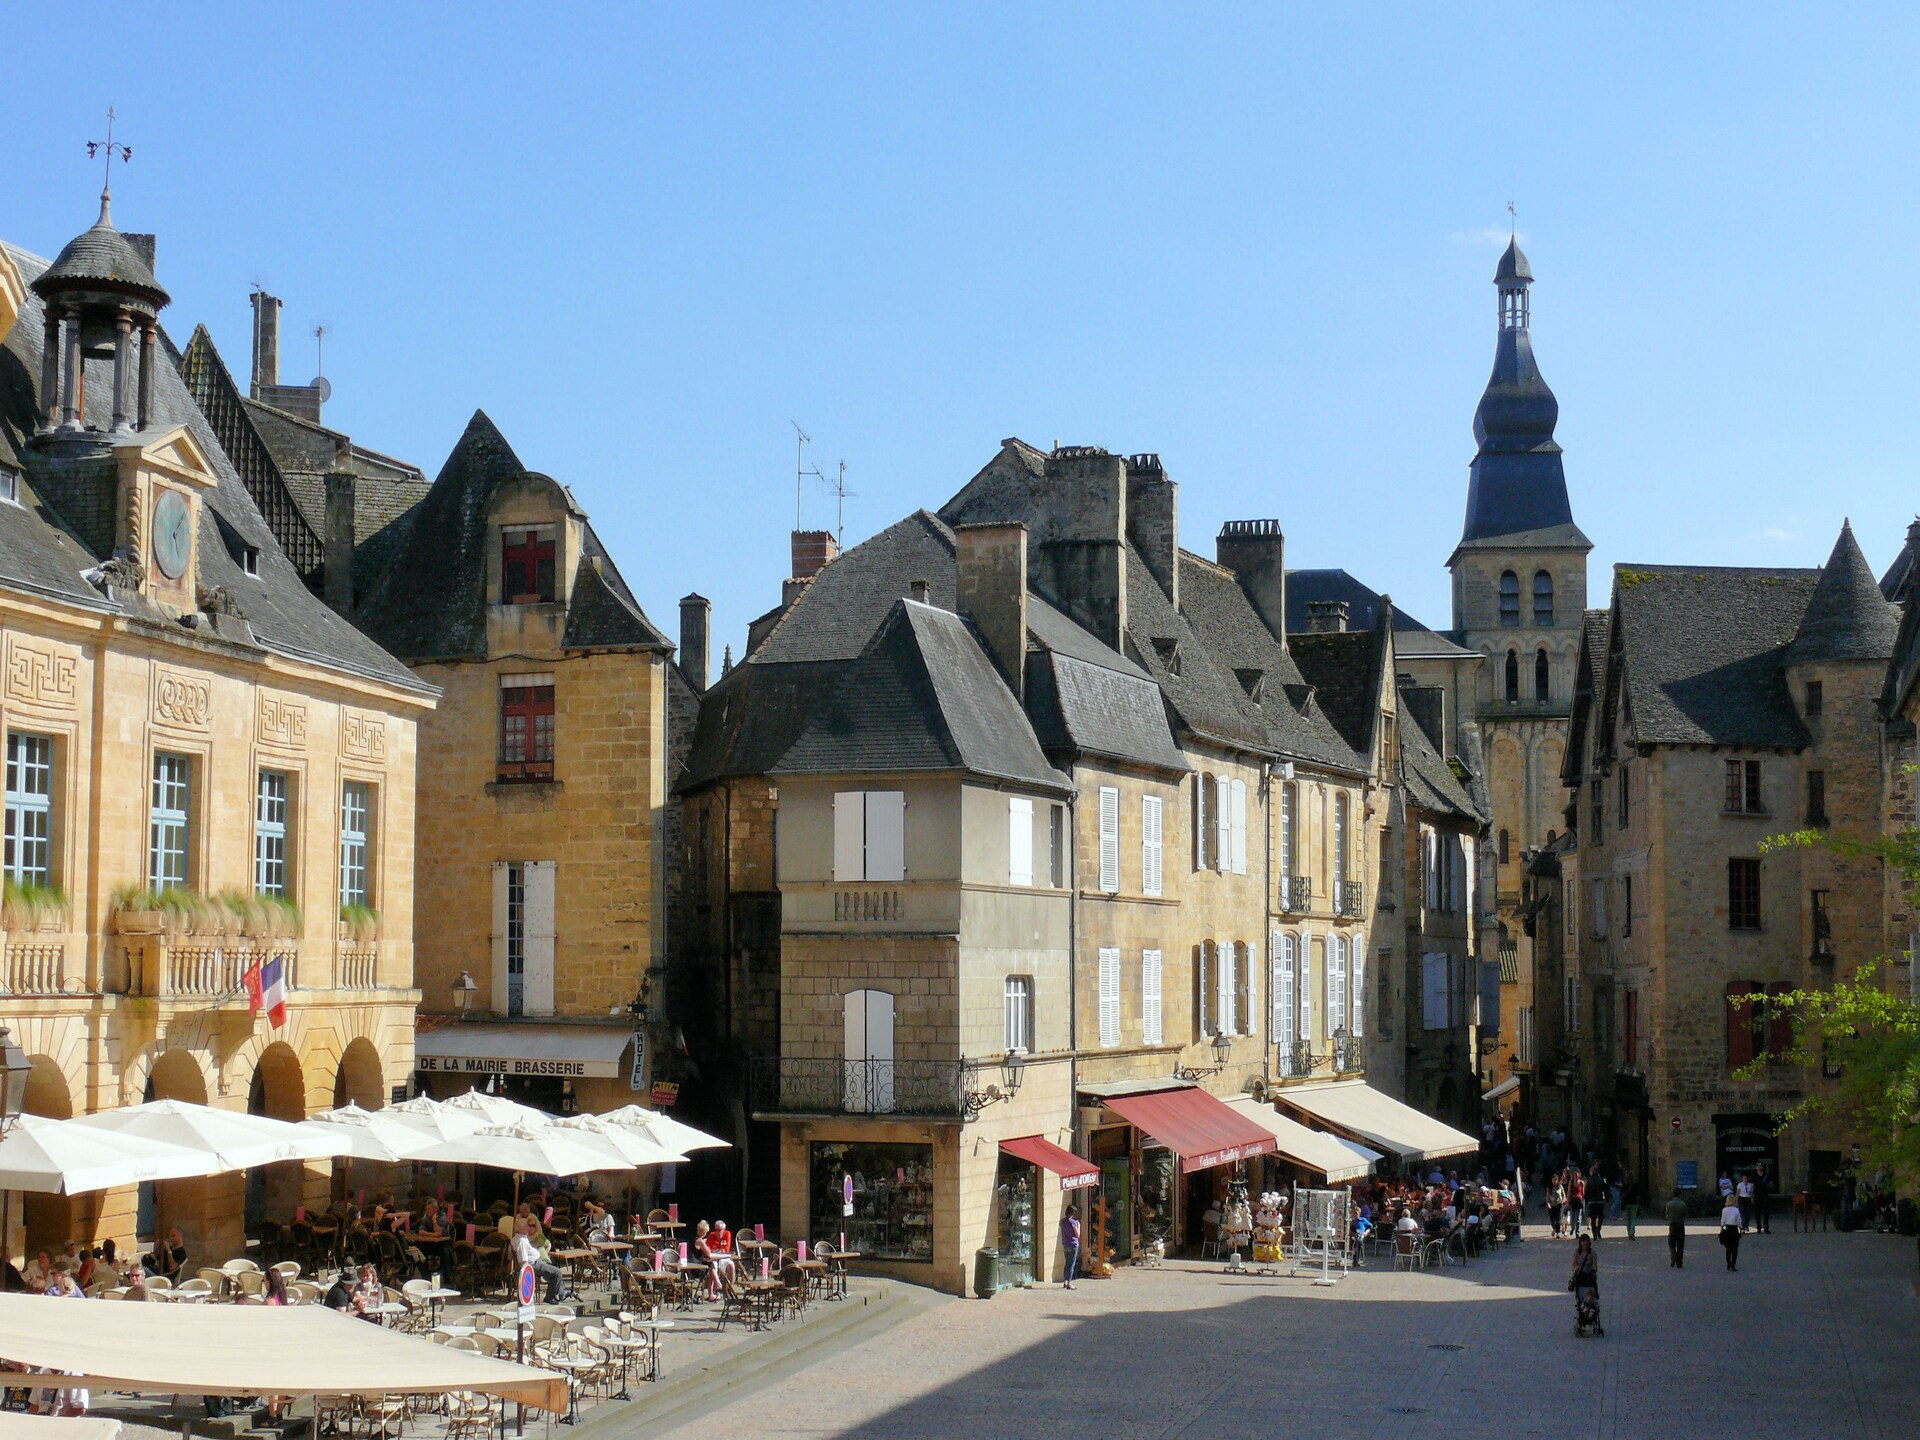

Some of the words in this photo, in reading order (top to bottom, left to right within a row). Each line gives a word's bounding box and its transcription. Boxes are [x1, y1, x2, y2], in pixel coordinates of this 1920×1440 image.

[420, 1057, 437, 1070] DE
[444, 1058, 459, 1071] LA
[466, 1060, 507, 1072] MAIRIE
[515, 1061, 584, 1075] BRASSERIE
[633, 1033, 643, 1084] HOTEL
[1062, 1176, 1078, 1188] Plaisir
